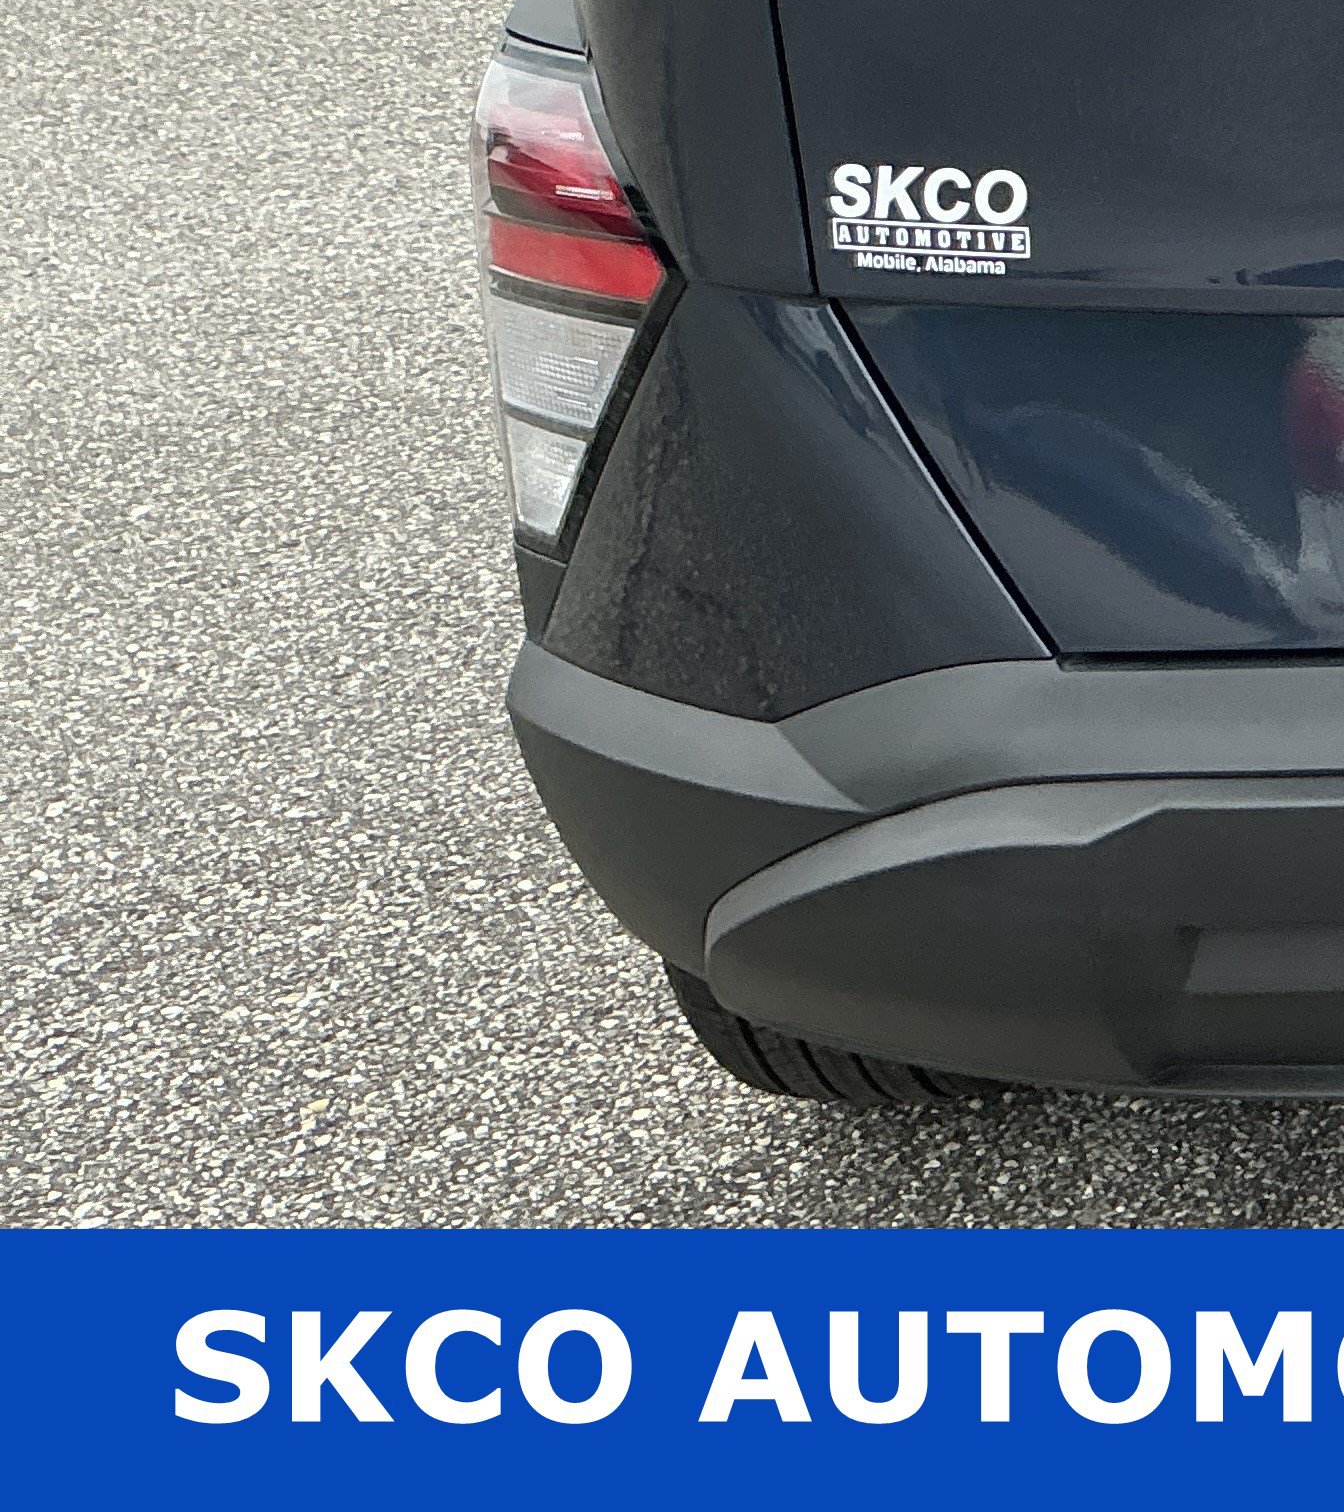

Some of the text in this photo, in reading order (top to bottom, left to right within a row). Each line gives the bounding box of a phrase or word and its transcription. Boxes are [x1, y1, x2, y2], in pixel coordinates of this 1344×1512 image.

[830, 163, 1028, 225] SKCO
[838, 225, 1025, 251] AUTOMOTIVE
[857, 252, 1006, 275] Mobile, Alabama
